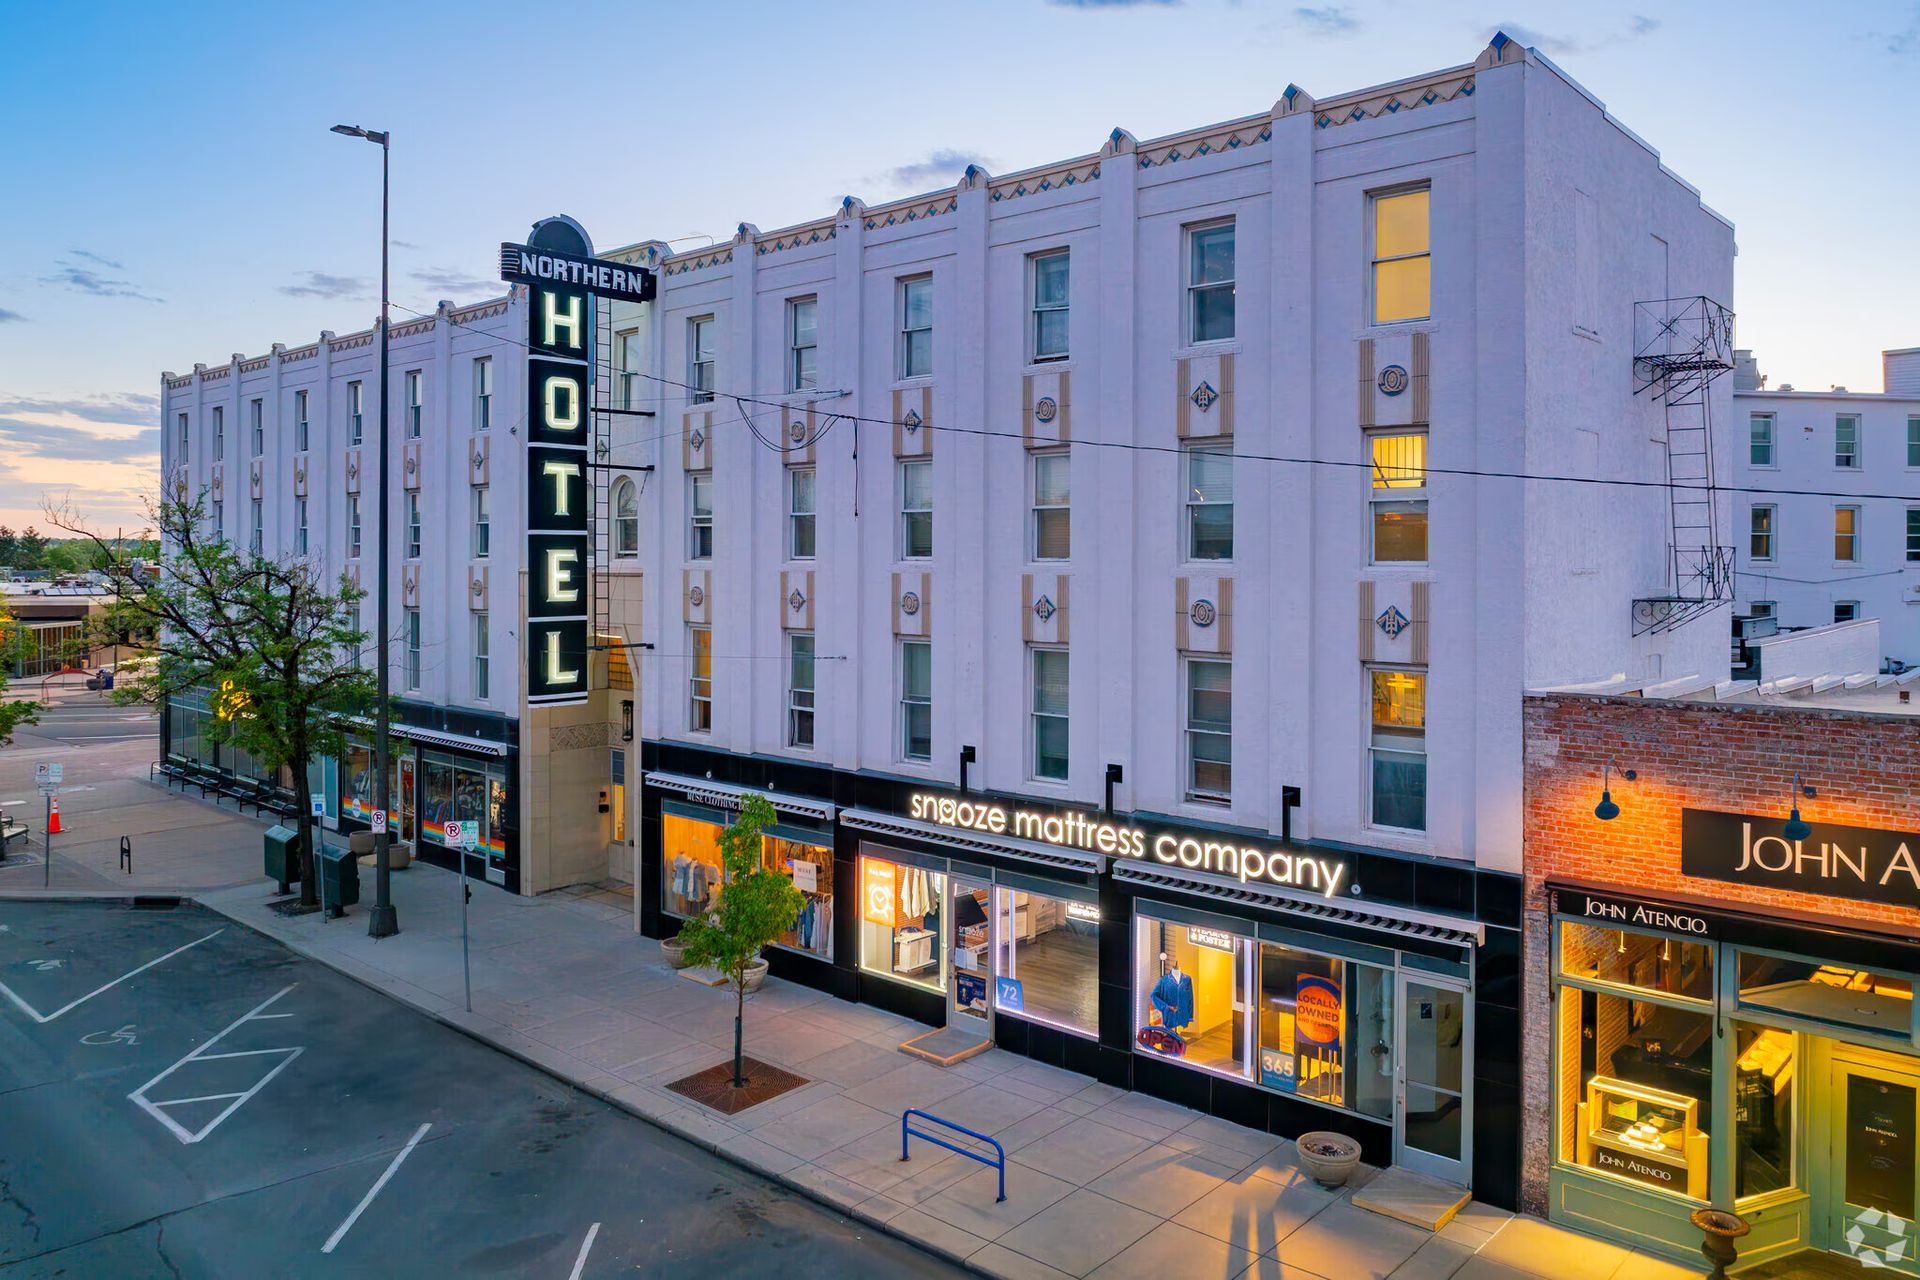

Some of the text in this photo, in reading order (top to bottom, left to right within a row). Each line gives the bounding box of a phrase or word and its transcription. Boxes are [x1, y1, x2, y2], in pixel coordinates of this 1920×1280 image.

[520, 251, 642, 294] NORTHERN
[542, 291, 582, 686] HOTEL
[687, 791, 704, 804] MUSE
[704, 795, 738, 810] CLOTHING
[911, 794, 1344, 898] snooze mattress company
[1735, 822, 1867, 883] JOHN
[1584, 896, 1627, 920] JOHN
[1198, 933, 1231, 949] FOSTER
[1002, 983, 1018, 1001] 72
[1297, 994, 1340, 1010] LOCALLY
[1297, 1005, 1339, 1022] OWNED
[1137, 1030, 1187, 1056] OPEN
[1263, 1055, 1295, 1078] 365
[1599, 1152, 1672, 1181] JOHN ATENCIO
